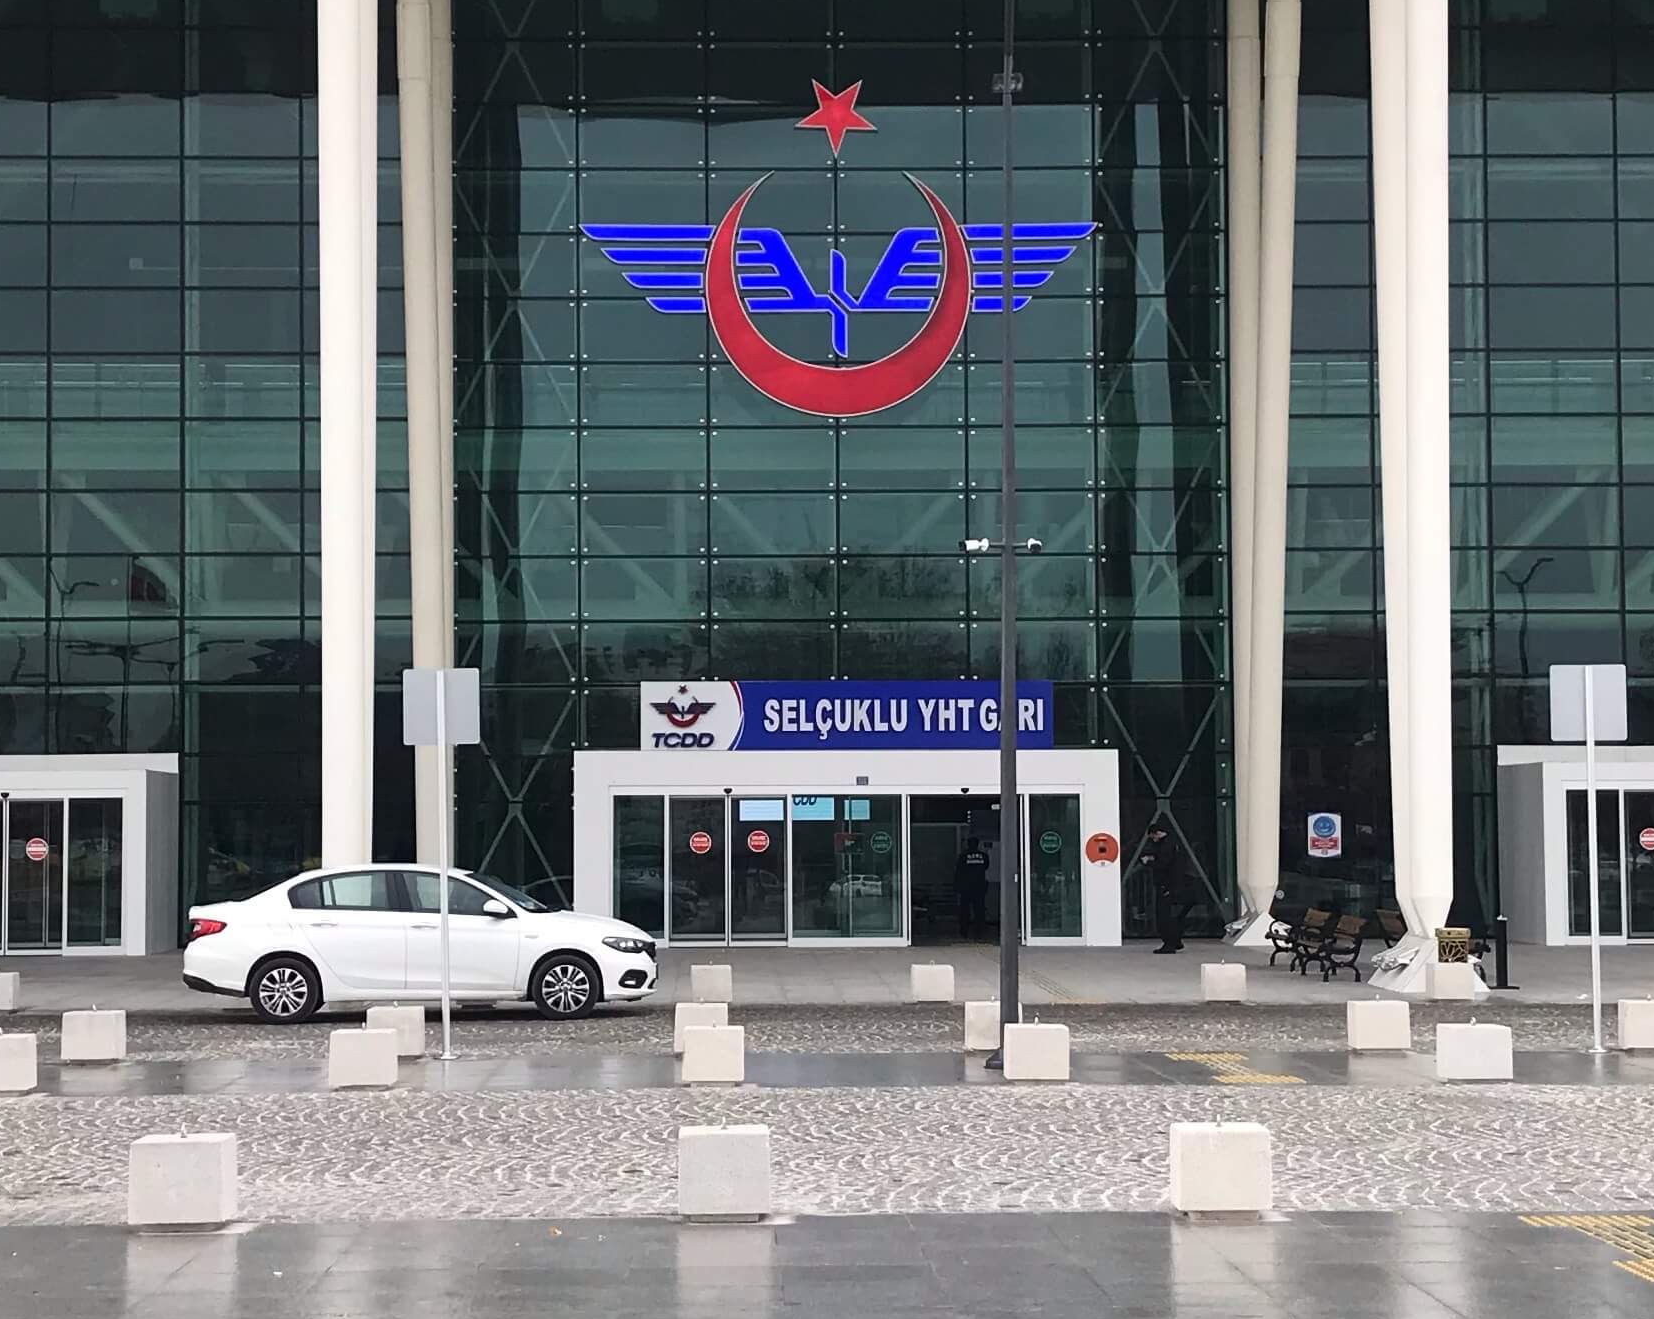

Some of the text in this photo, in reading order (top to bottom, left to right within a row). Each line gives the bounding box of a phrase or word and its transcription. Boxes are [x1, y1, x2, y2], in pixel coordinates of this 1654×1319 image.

[763, 698, 1044, 740] SELÇUKLU YHT GRI
[651, 732, 715, 749] TCDD
